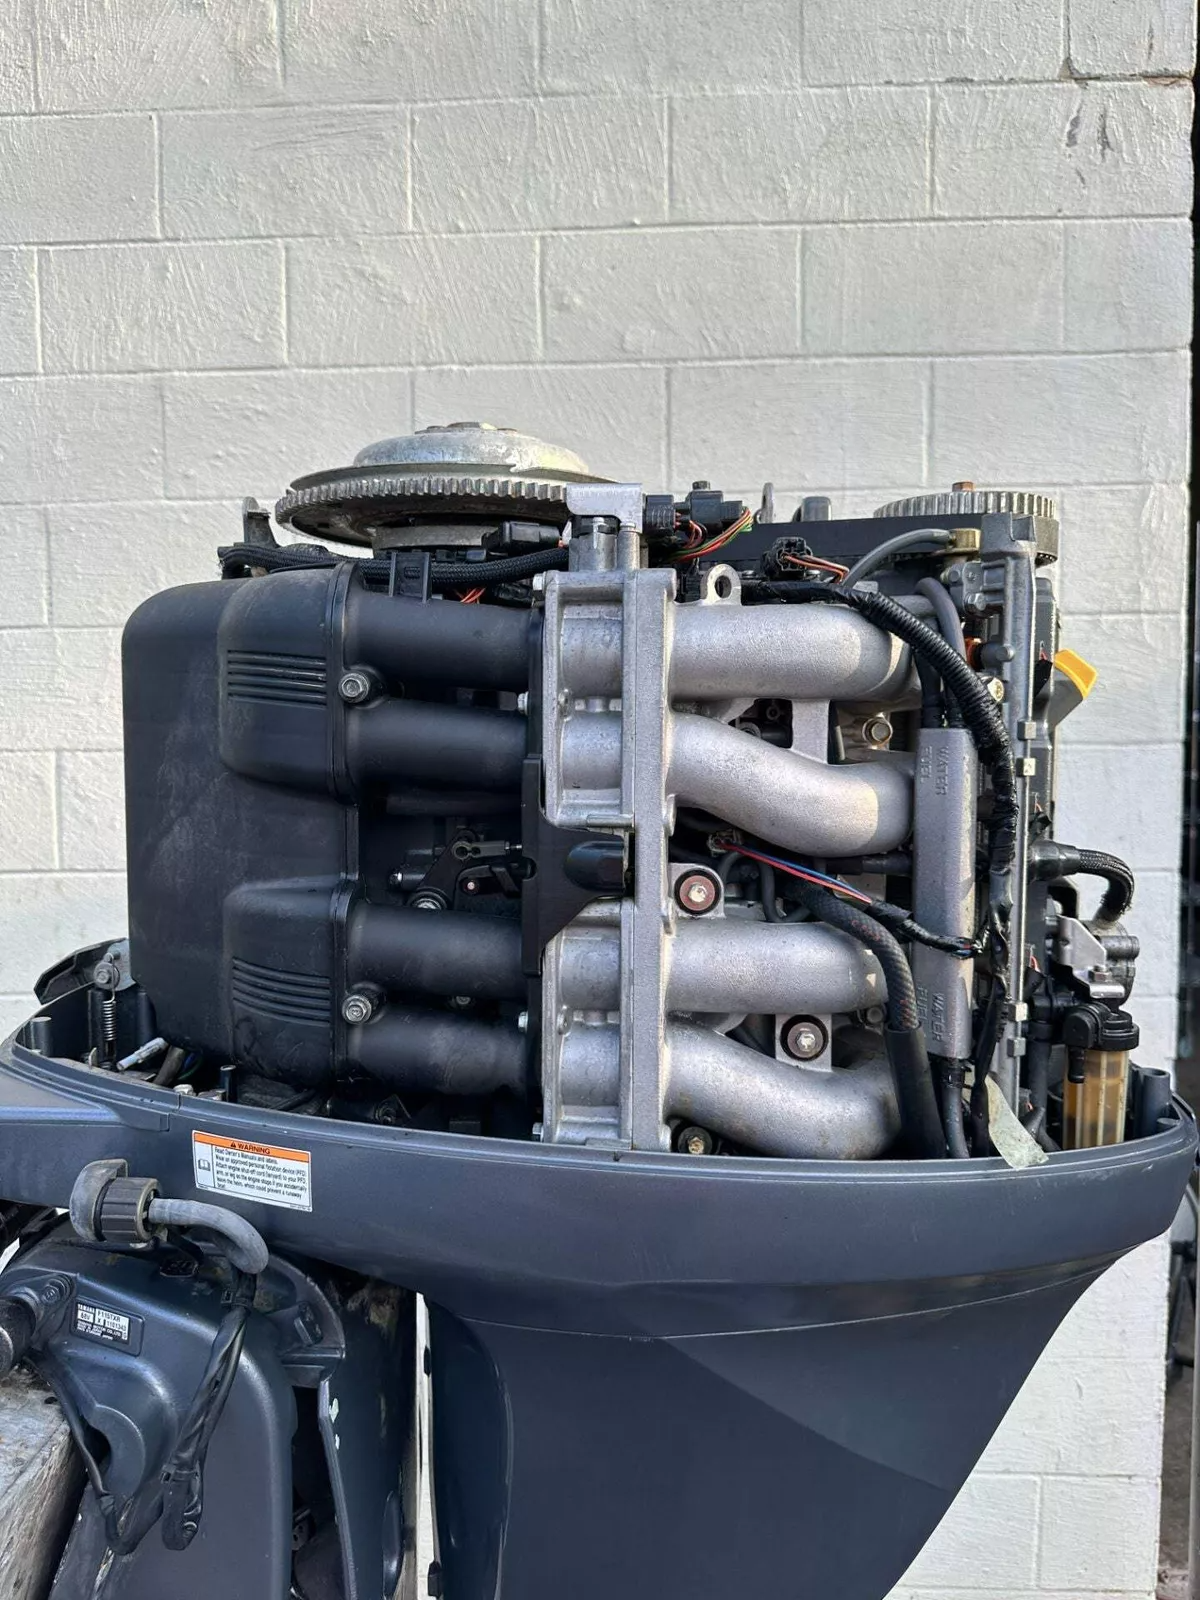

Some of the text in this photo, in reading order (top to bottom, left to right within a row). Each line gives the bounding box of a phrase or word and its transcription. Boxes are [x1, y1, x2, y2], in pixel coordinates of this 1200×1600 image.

[936, 747, 949, 795] WATER
[932, 992, 946, 1043] WATER
[237, 1142, 270, 1154] WARNING
[227, 1164, 240, 1172] engine
[240, 1166, 255, 1174] shut-off
[230, 1157, 247, 1166] approved
[248, 1160, 264, 1169] personal
[247, 1176, 259, 1184] engine
[283, 1182, 306, 1193] accidentally
[267, 1187, 281, 1195] prevent
[285, 1190, 301, 1199] runaway
[98, 1310, 120, 1322] F115TXR
